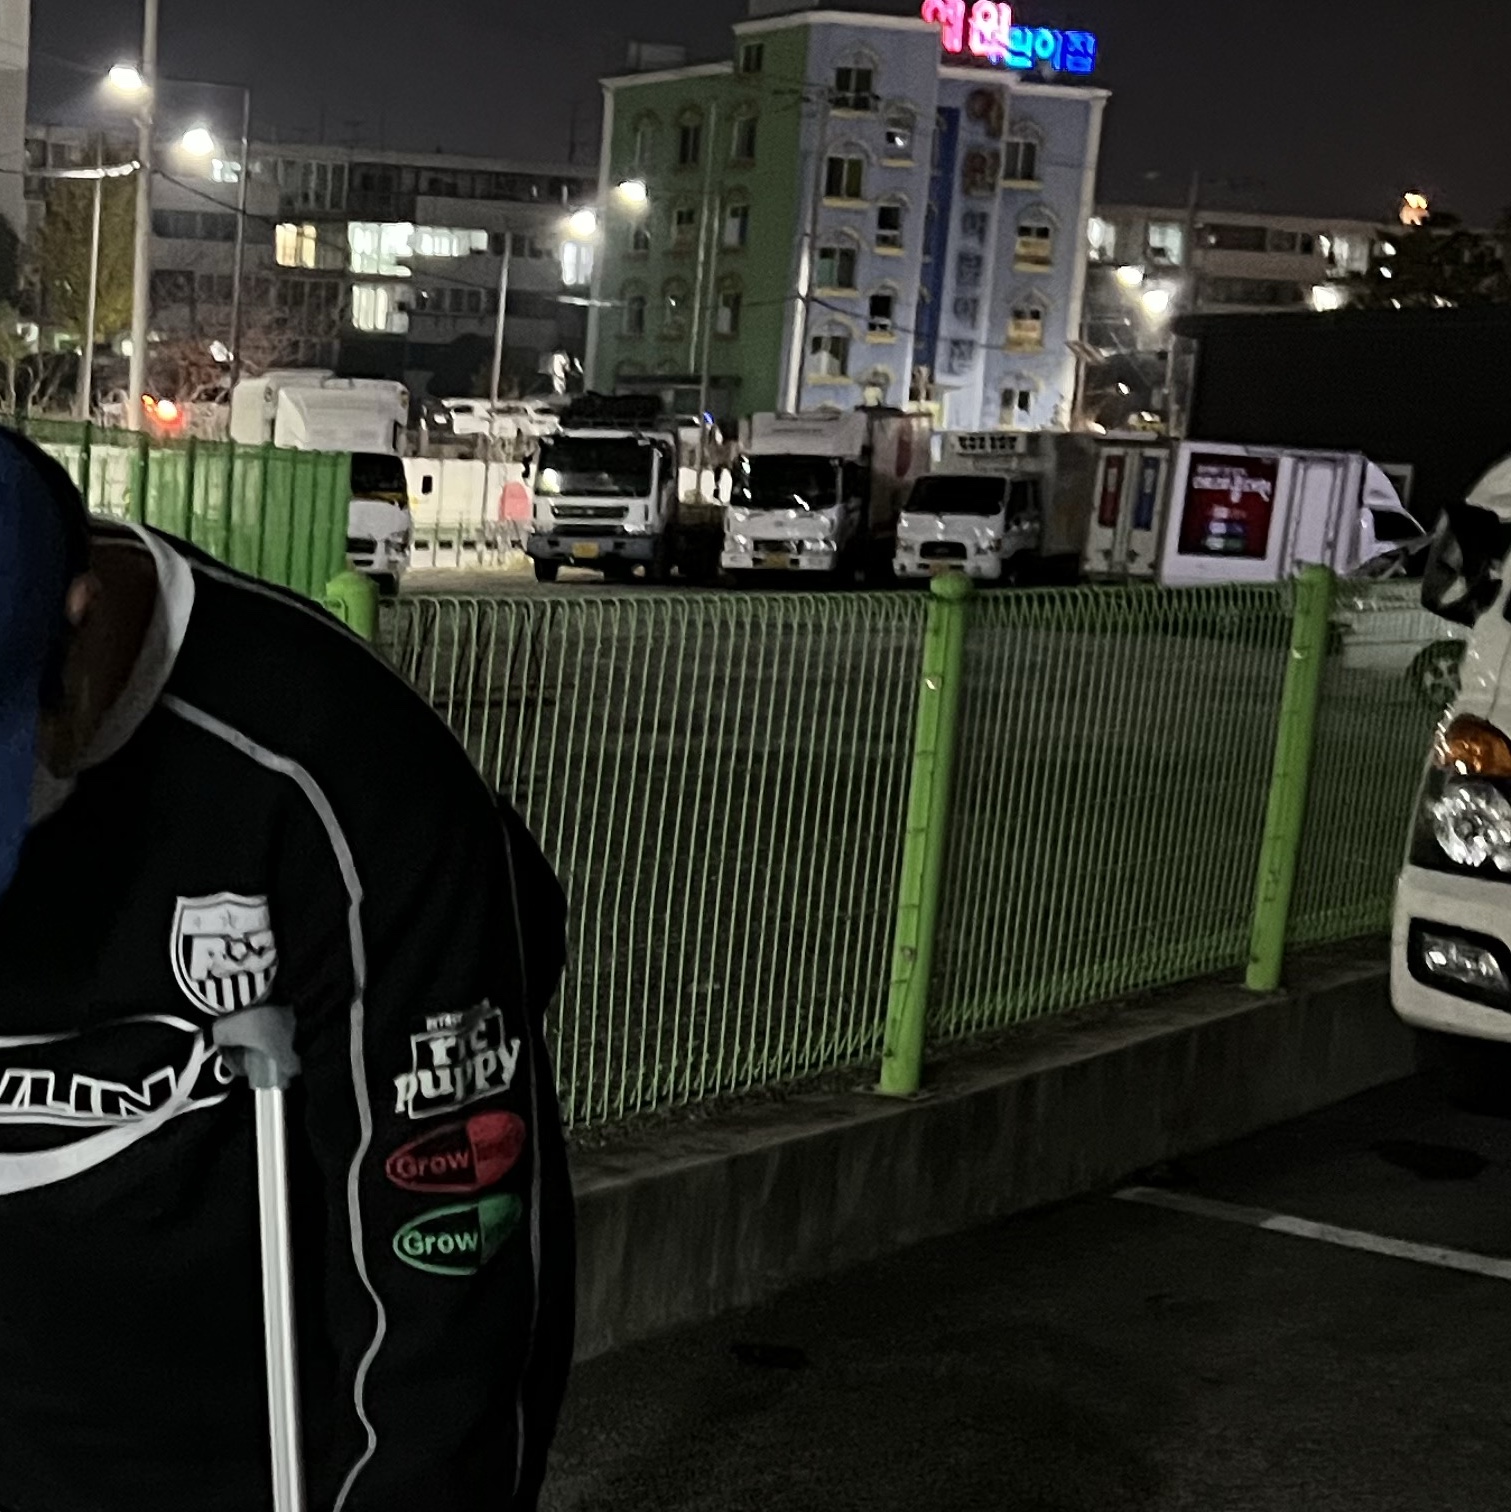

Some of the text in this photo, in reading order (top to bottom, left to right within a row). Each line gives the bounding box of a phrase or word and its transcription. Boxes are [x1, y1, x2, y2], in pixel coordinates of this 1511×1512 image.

[991, 25, 1097, 75] 린이집
[395, 1151, 470, 1180] Grow
[402, 1228, 480, 1256] Grow
